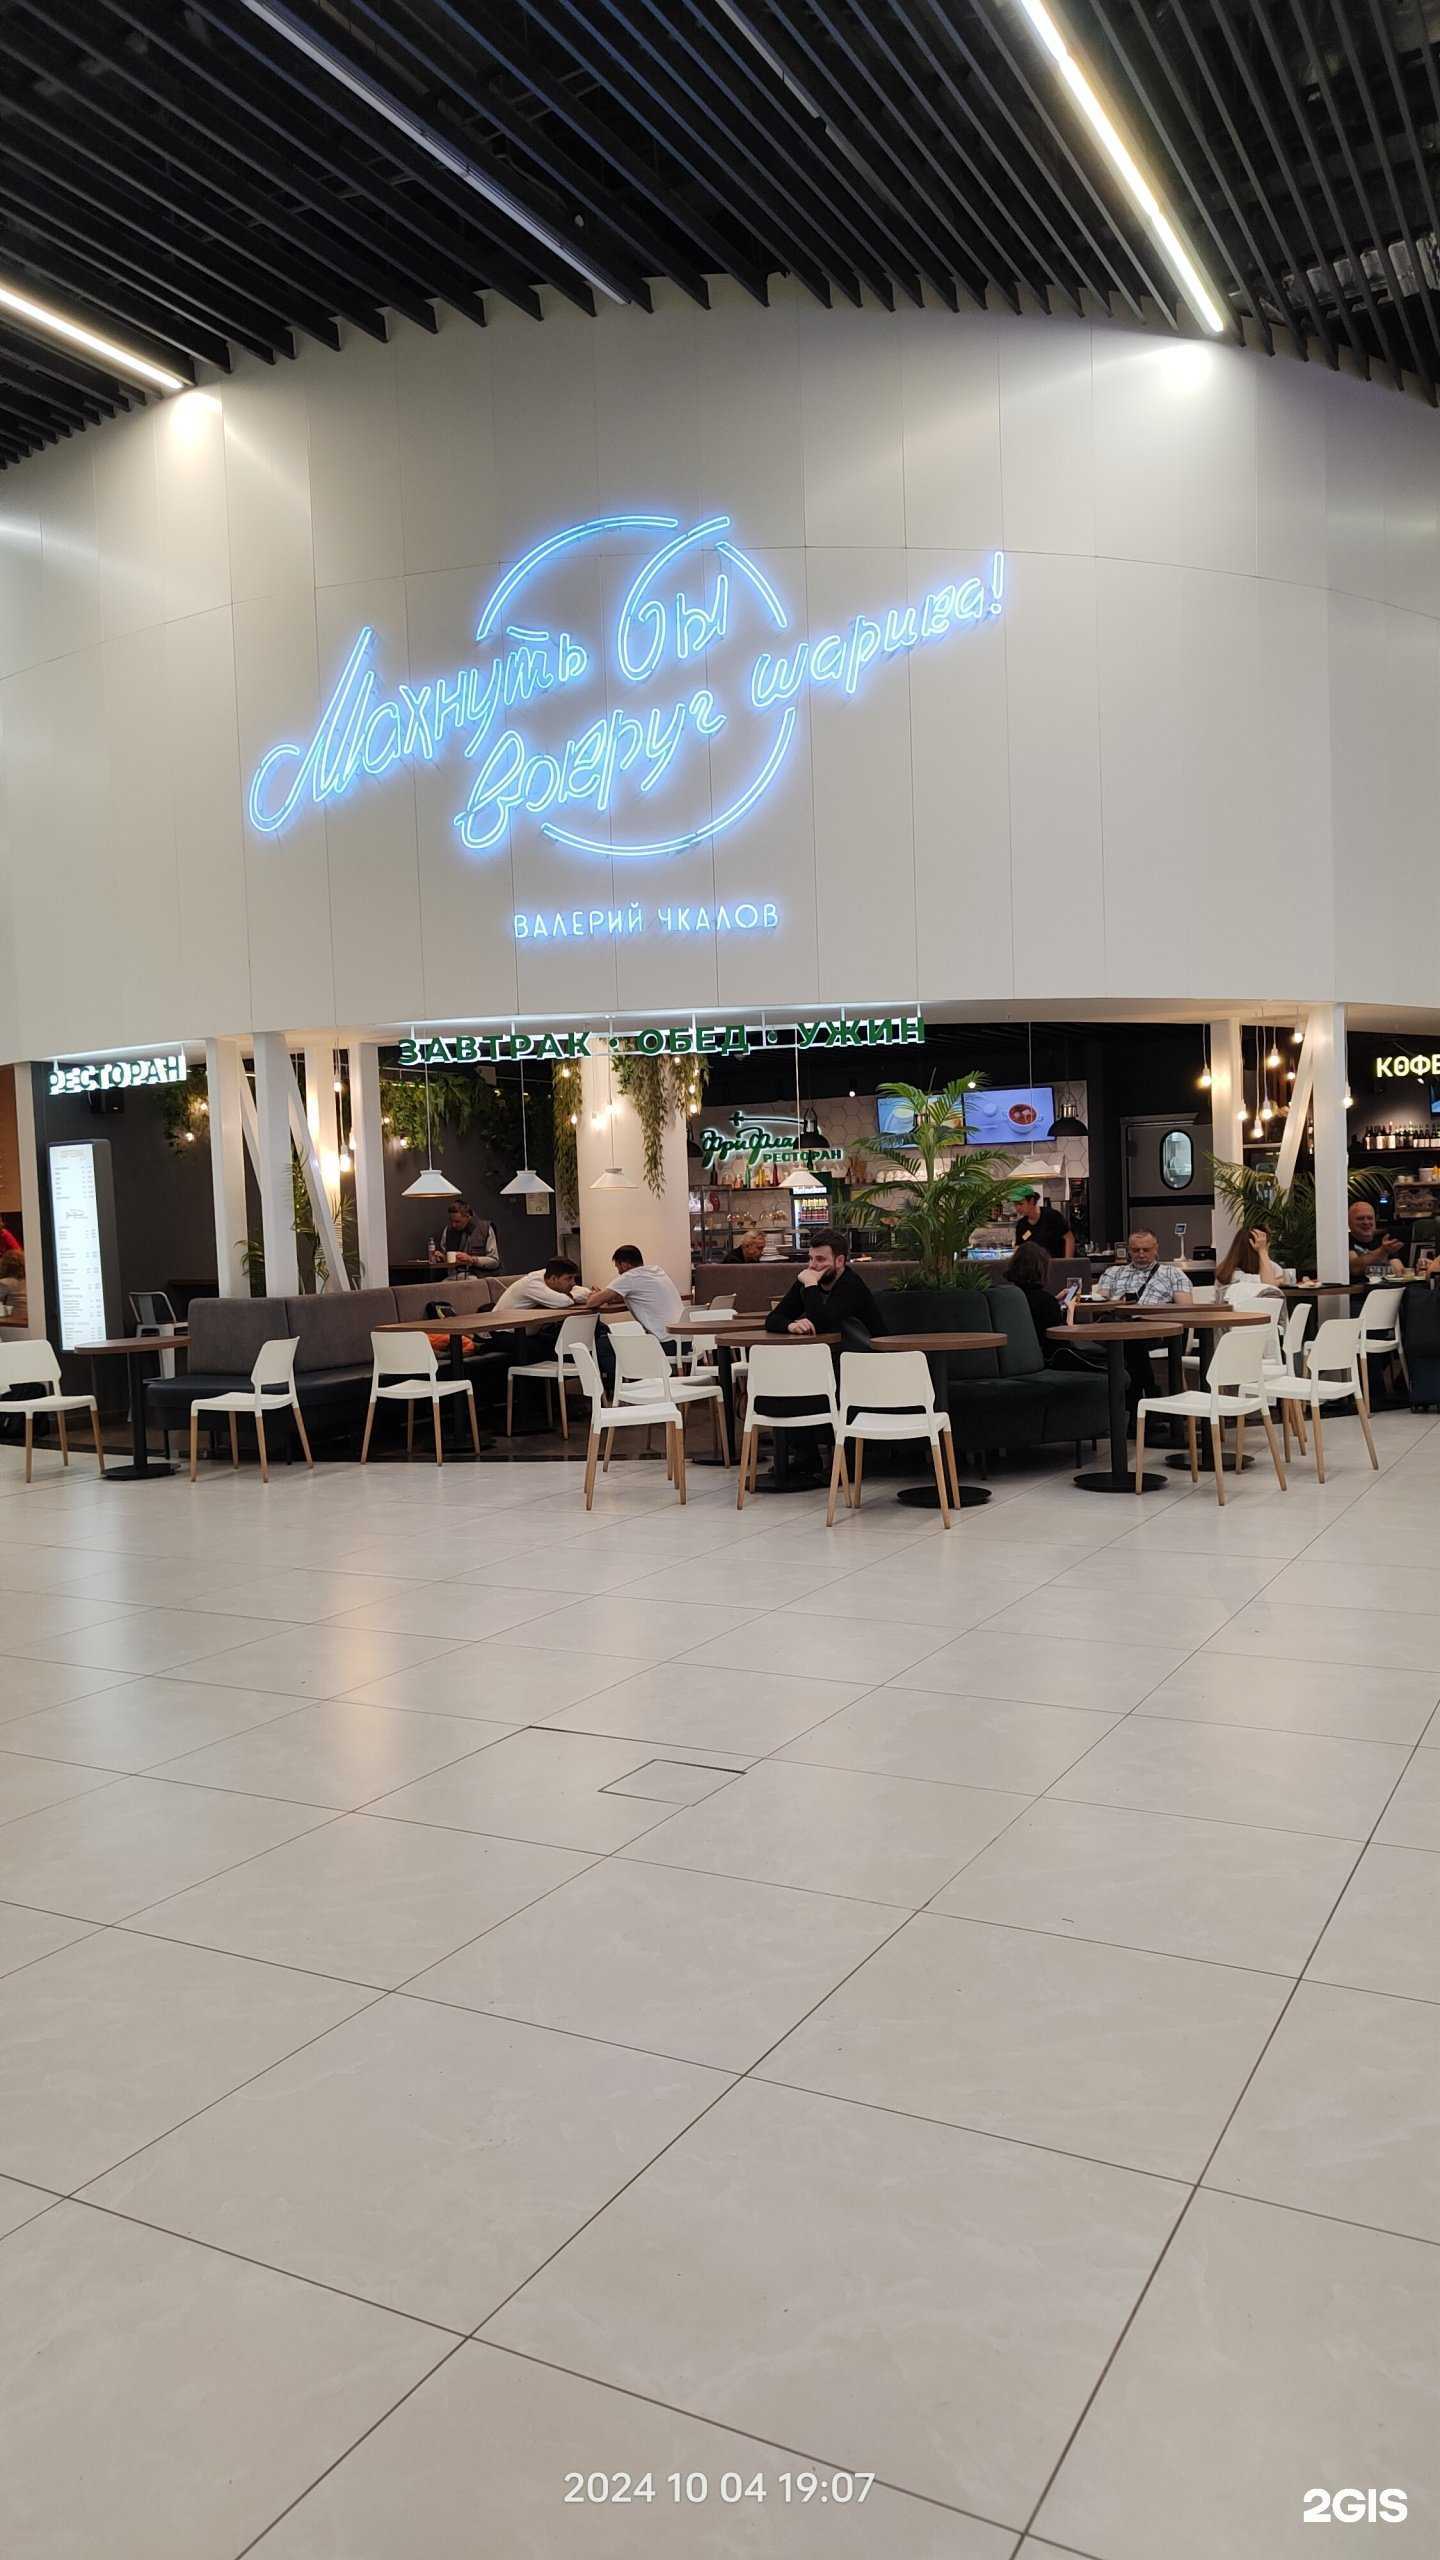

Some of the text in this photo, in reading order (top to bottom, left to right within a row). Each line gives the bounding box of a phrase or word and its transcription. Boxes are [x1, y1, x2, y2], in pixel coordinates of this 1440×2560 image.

[751, 551, 1004, 707] шарика!
[249, 626, 588, 832] Махнуть
[514, 902, 779, 938] ВАЛЕРИЙ ЧКАЛОВ
[399, 1017, 926, 1065] ЗАВТРАК ОБЕД УЖИН
[48, 1055, 187, 1095] РЕСТОРАН
[763, 1149, 843, 1163] РЕСТОРАН
